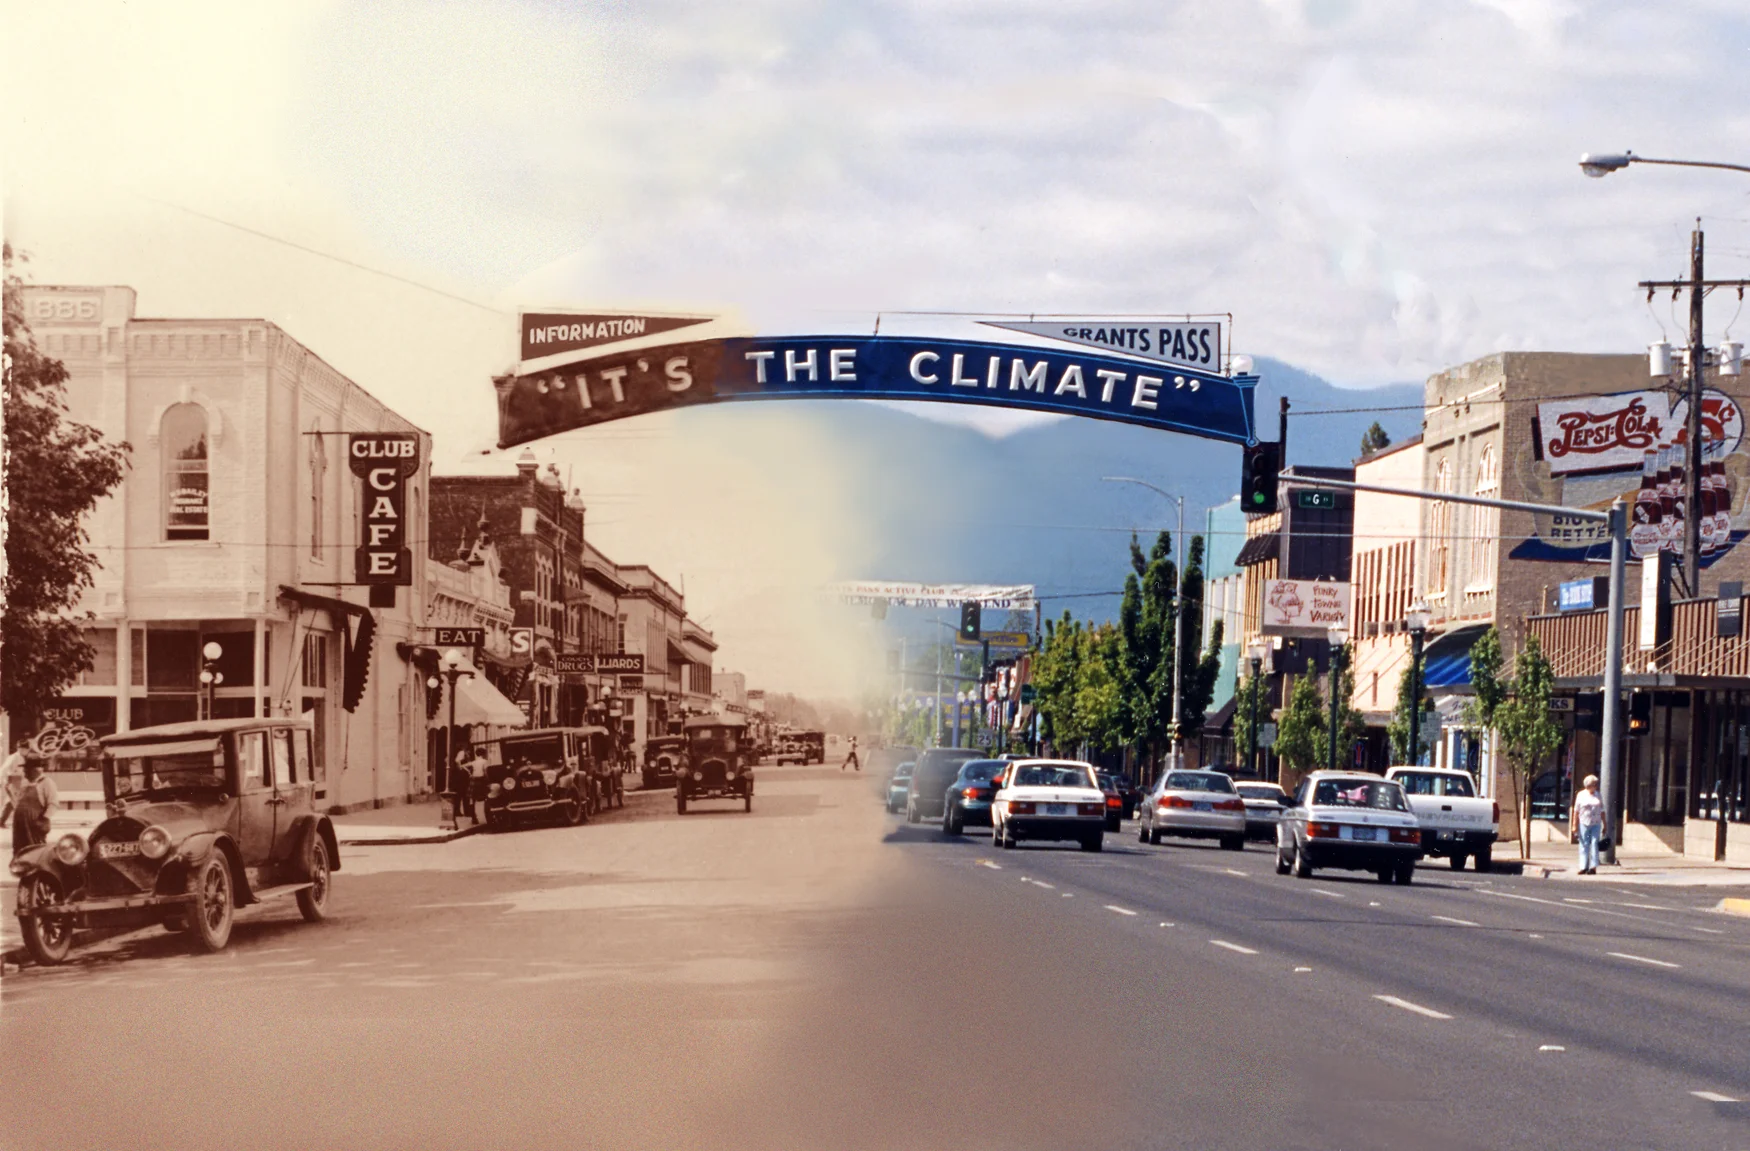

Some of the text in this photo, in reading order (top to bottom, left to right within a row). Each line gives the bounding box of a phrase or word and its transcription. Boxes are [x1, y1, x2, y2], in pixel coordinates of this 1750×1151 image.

[529, 318, 646, 344] INFORMATION
[1063, 327, 1213, 364] GRANTS PASS
[745, 348, 858, 384] THE
[351, 440, 416, 458] CLUB
[1312, 493, 1320, 504] G
[368, 467, 398, 575] CAFE
[439, 630, 481, 643] EAT
[557, 661, 594, 670] DRUGS
[47, 708, 84, 720] CLUB
[1415, 811, 1485, 823] HEVROLET
